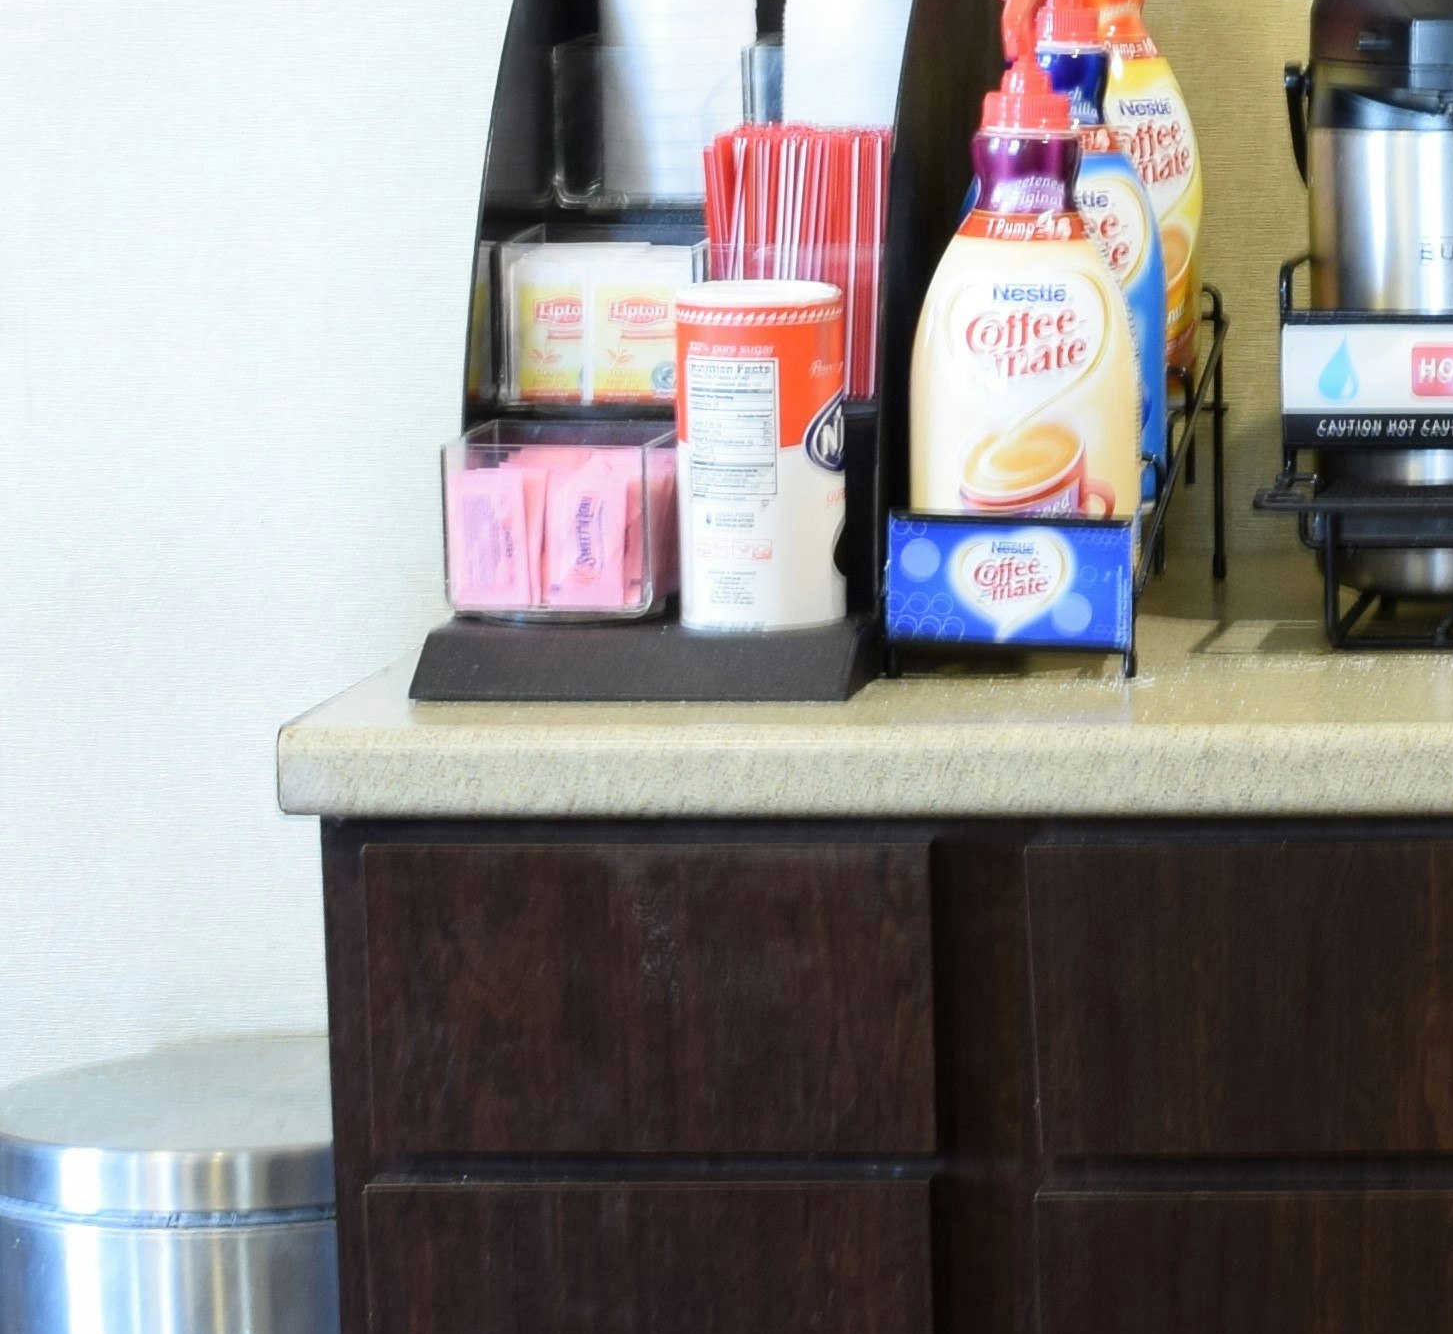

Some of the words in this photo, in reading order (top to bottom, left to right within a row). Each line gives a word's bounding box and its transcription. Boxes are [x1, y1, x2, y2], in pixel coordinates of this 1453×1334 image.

[994, 217, 1035, 240] Pump
[540, 302, 582, 319] Lipto
[612, 302, 666, 319] Lipton
[711, 344, 737, 355] pure
[739, 345, 775, 357] sugar
[994, 337, 1088, 378] mate
[737, 365, 771, 375] Facts
[1316, 419, 1382, 437] CAUTION
[1386, 419, 1417, 437] HOT
[991, 576, 1049, 602] mate
